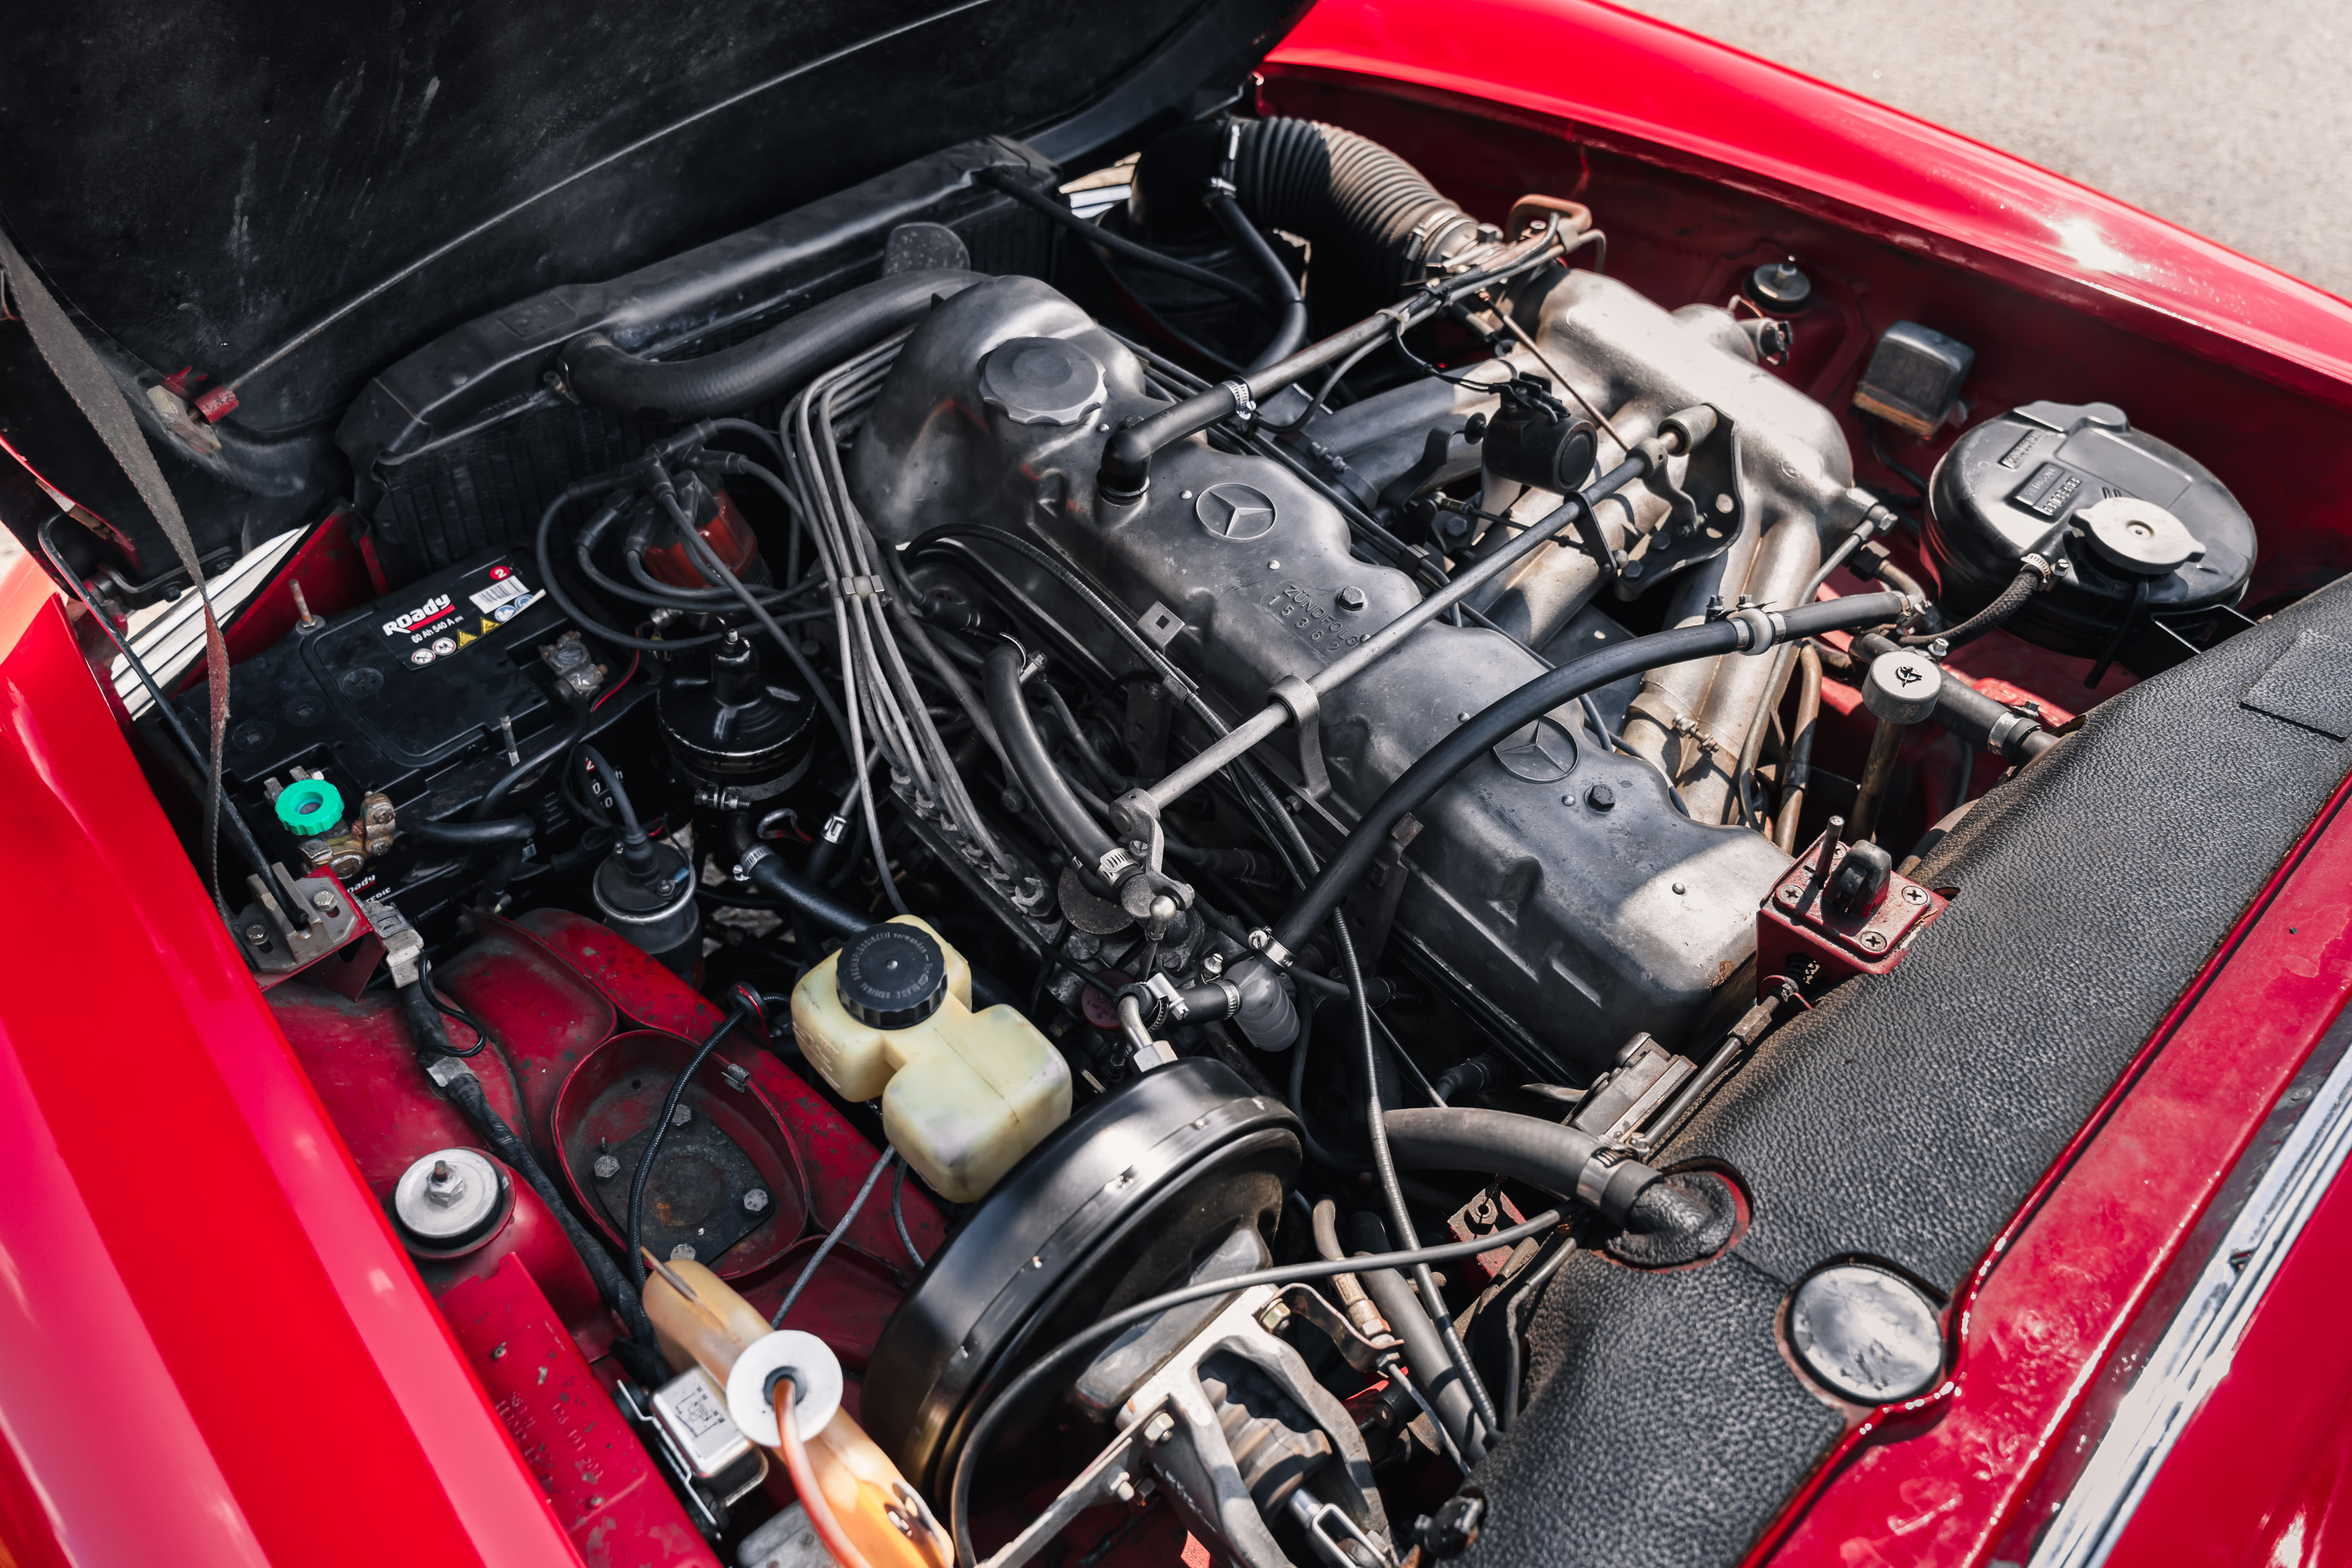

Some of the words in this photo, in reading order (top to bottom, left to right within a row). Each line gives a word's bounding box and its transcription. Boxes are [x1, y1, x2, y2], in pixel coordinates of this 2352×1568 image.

[494, 568, 507, 579] 2
[382, 593, 451, 636] Roady
[1281, 604, 1294, 616] 5
[1296, 617, 1309, 628] 3
[1310, 629, 1324, 641] 6
[1284, 585, 1359, 646] ZÜNDFOLG
[412, 634, 422, 643] 60
[422, 628, 434, 639] Ah
[433, 621, 447, 633] 540
[348, 874, 376, 894] oady
